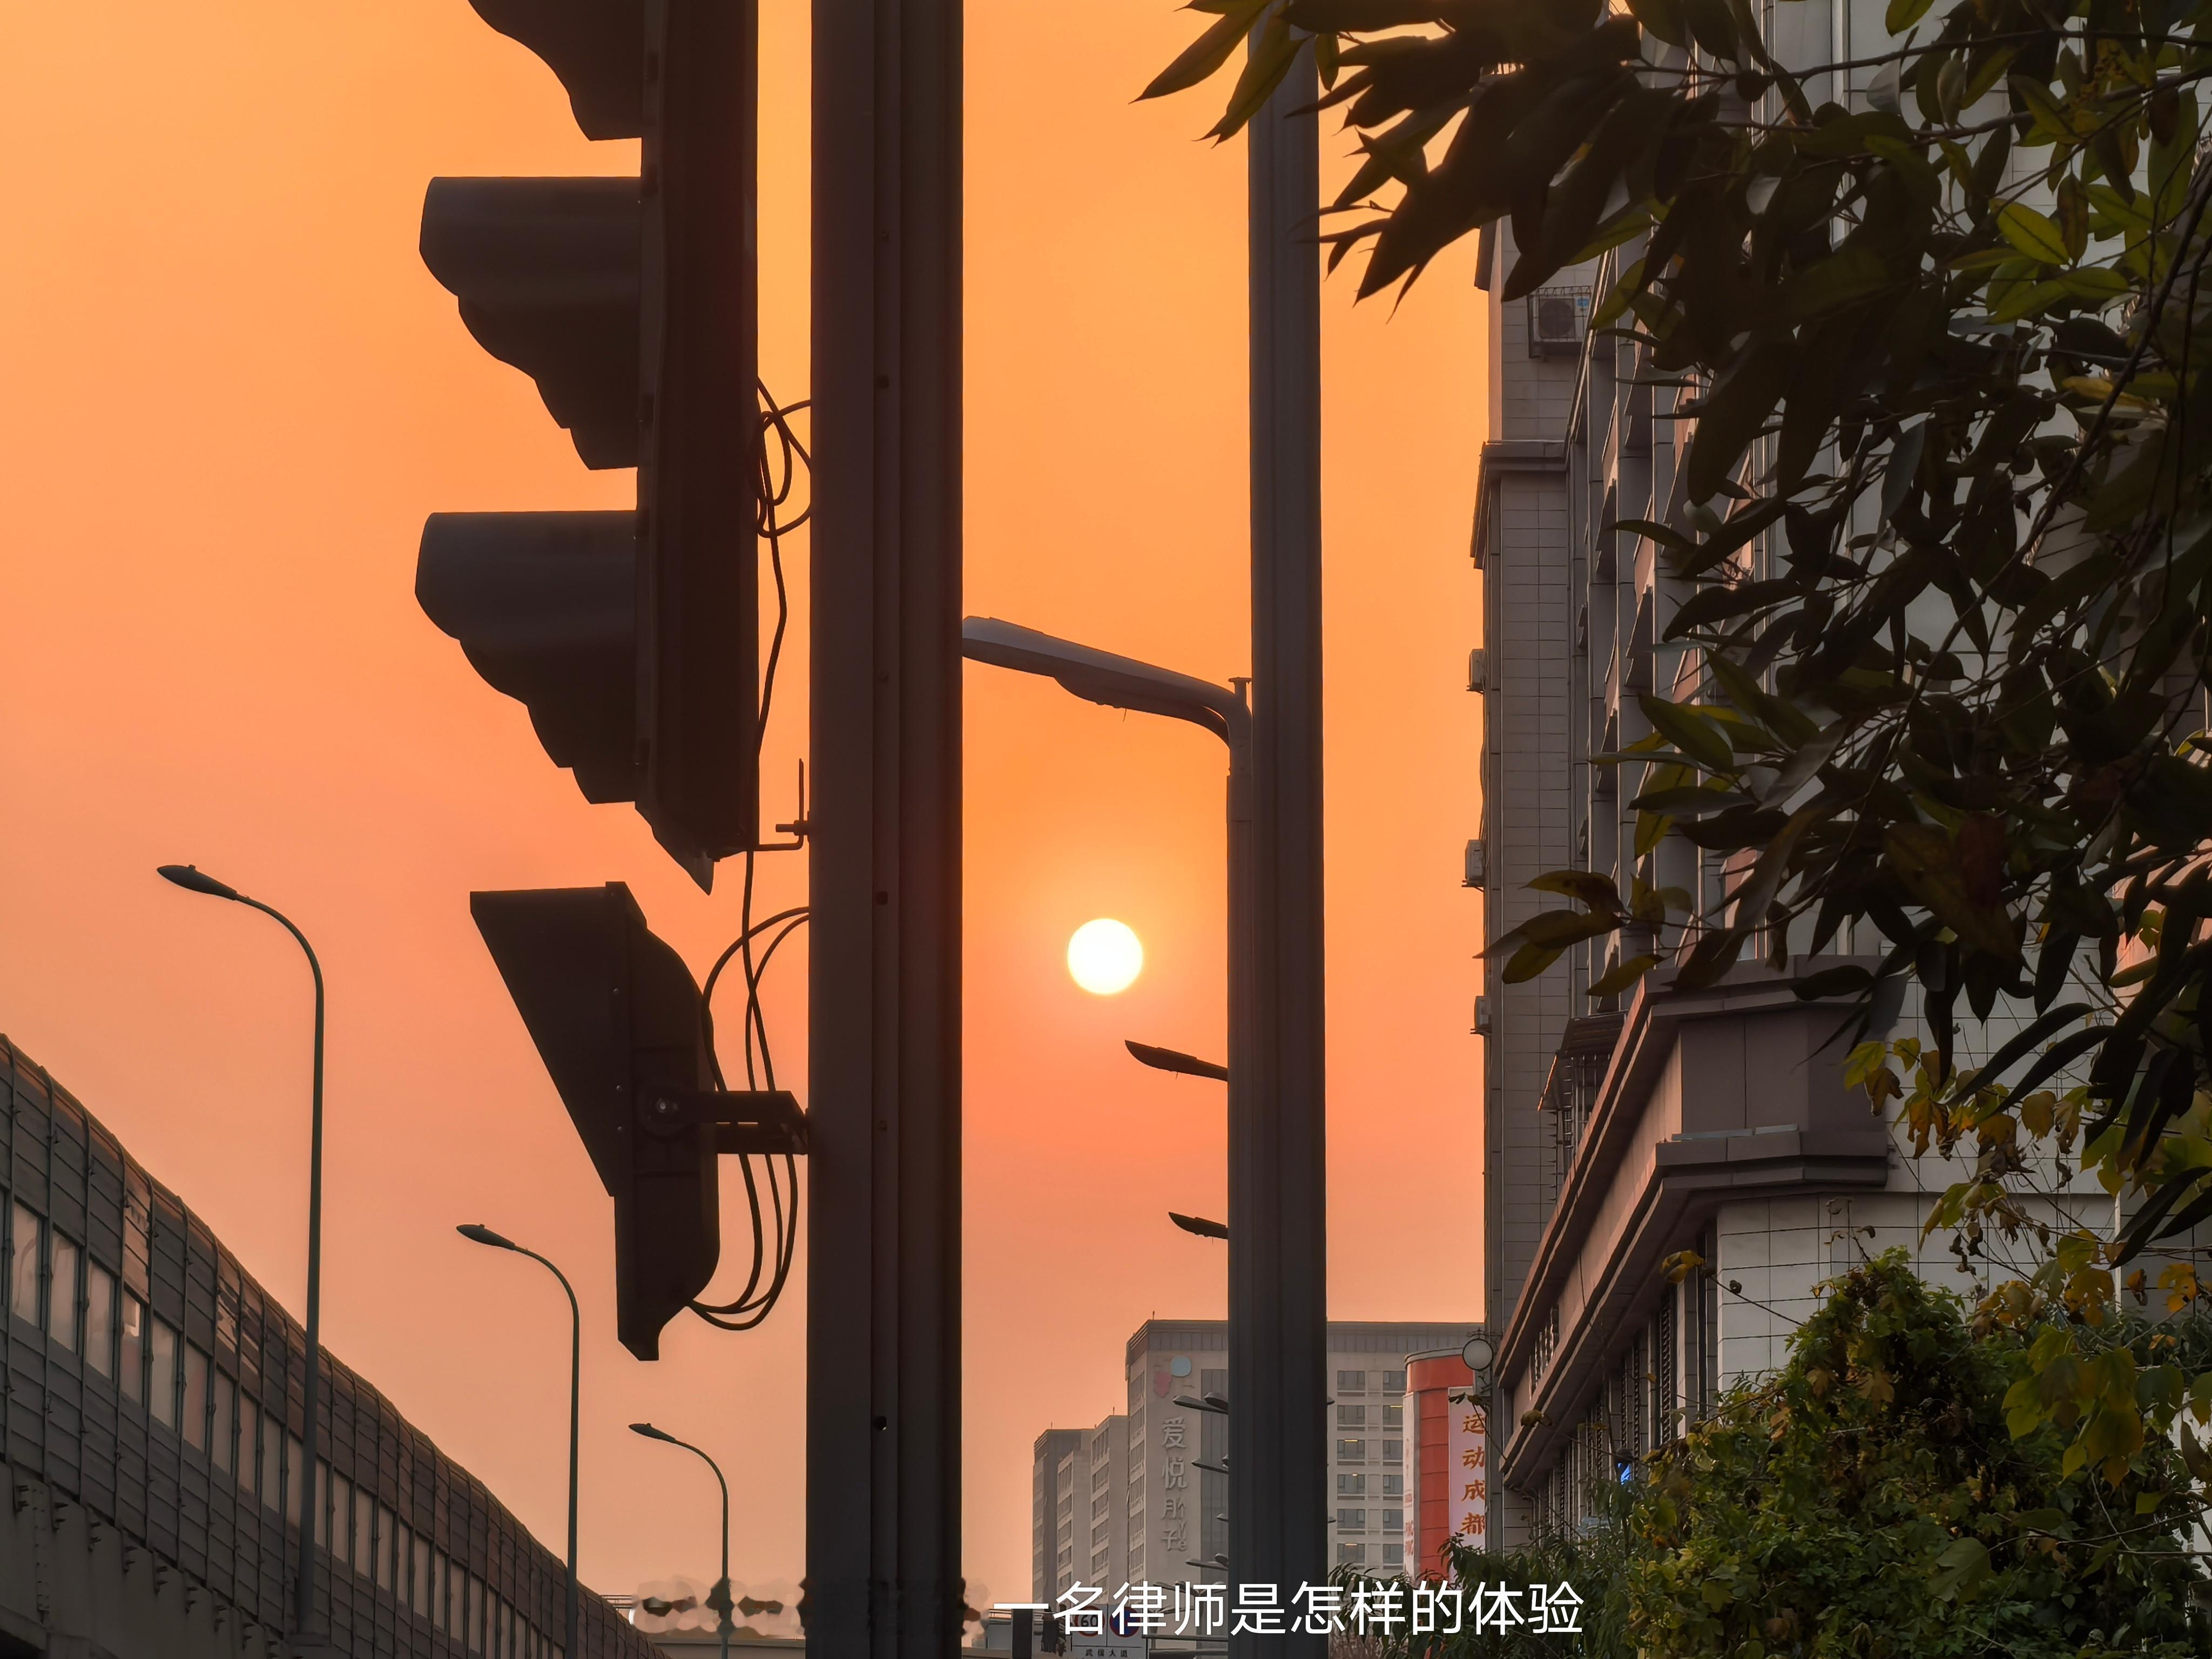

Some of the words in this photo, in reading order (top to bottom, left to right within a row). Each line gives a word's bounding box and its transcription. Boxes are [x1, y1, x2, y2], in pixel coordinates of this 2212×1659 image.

[1460, 1414, 1486, 1535] 运动成都
[1081, 1614, 1099, 1628] 60
